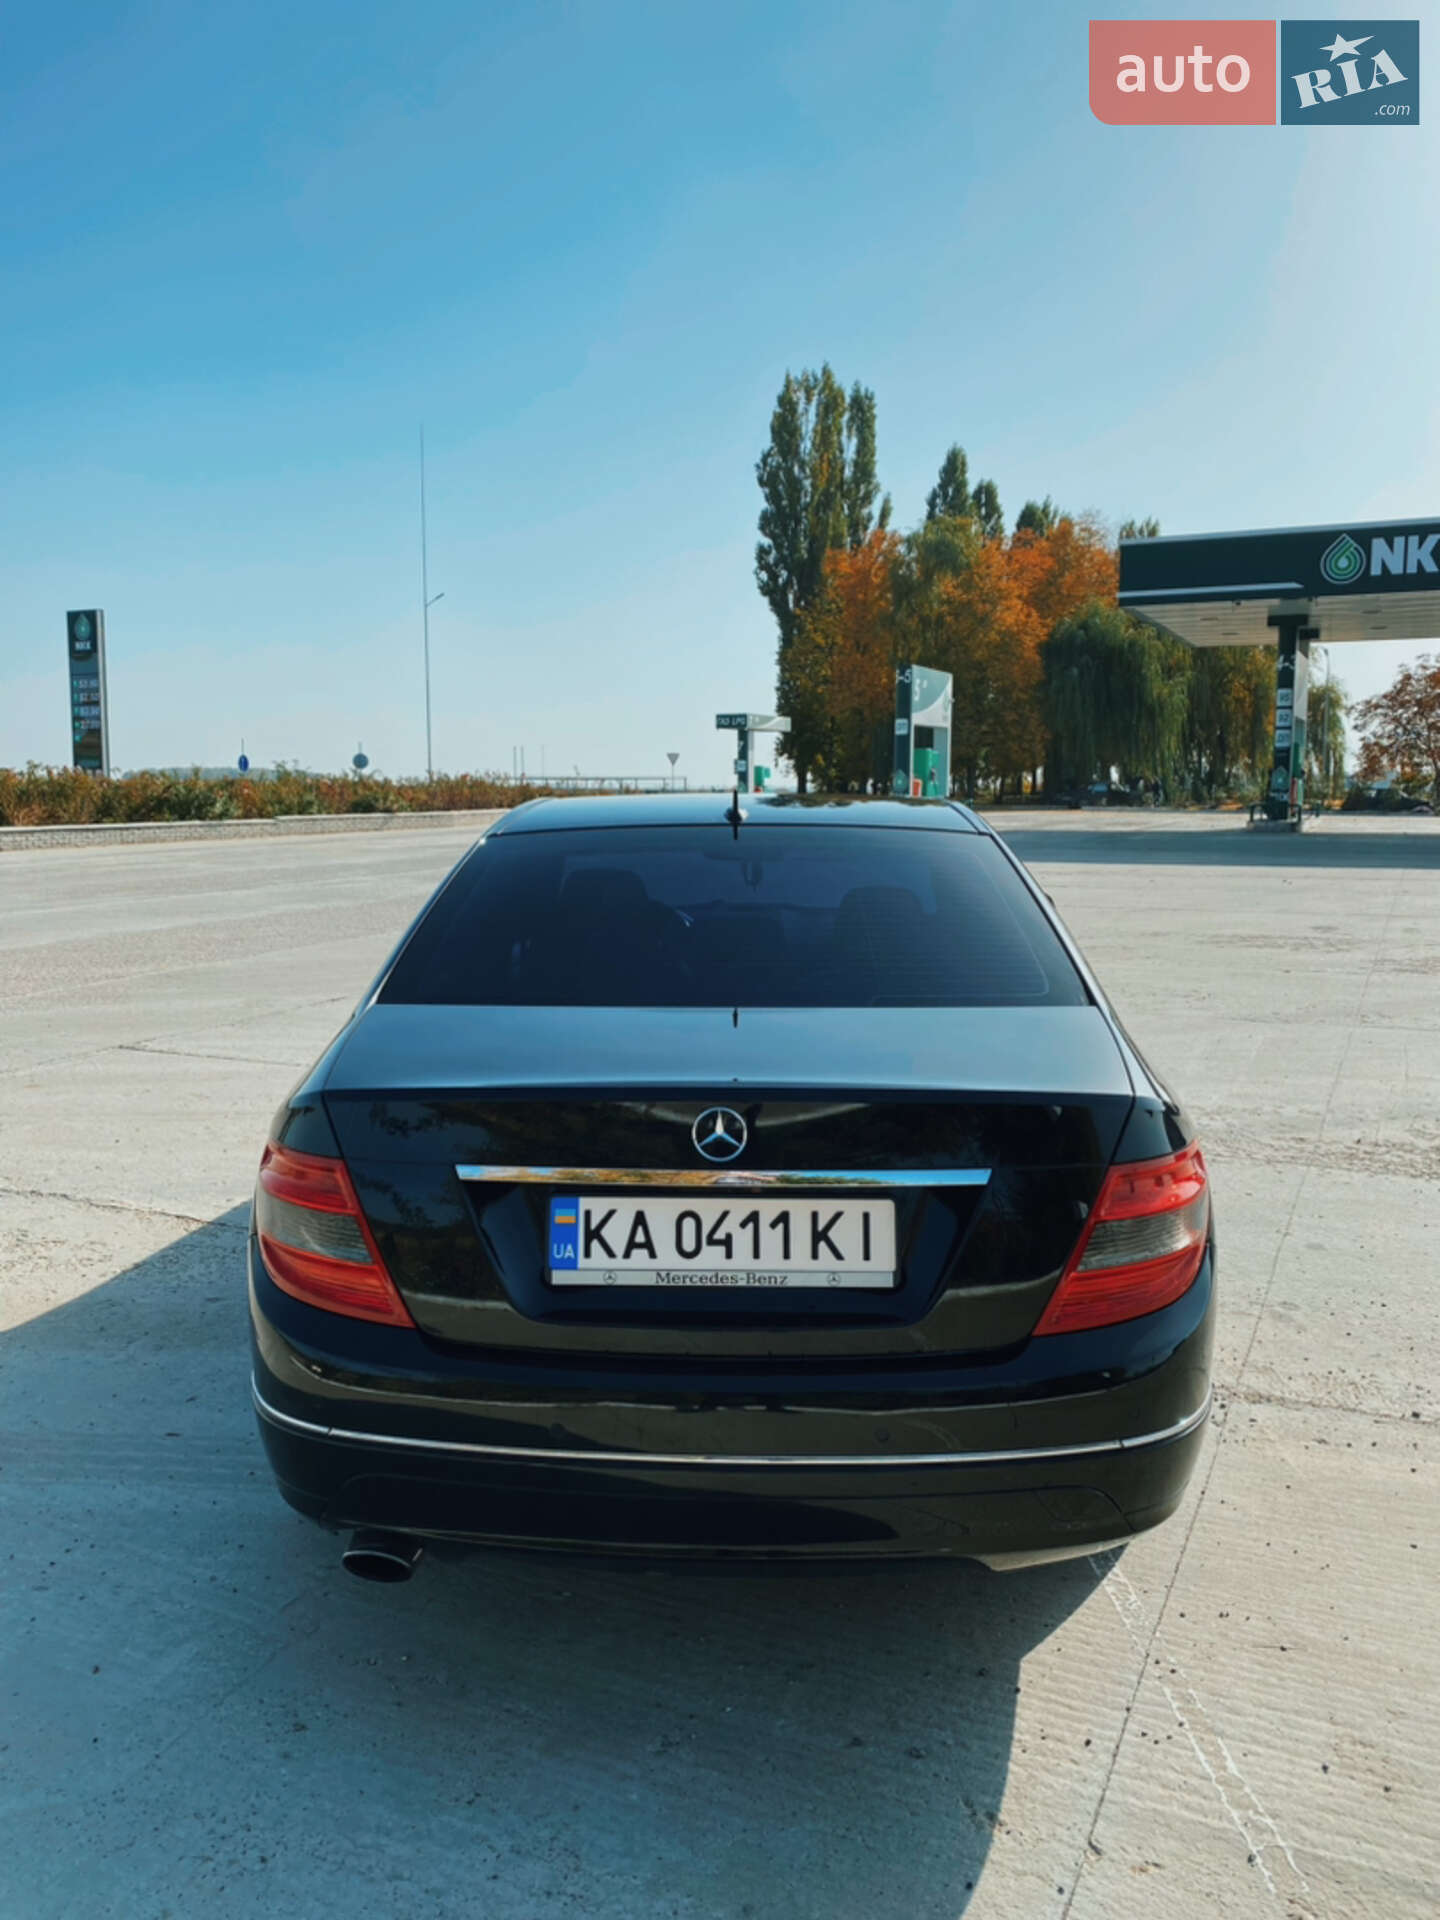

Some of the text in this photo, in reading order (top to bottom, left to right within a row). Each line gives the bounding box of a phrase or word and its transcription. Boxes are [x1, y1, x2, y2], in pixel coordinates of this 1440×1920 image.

[583, 1209, 870, 1261] KA 0411 KI
[553, 1243, 575, 1259] UA
[655, 1271, 788, 1286] Mercedes-Benz
